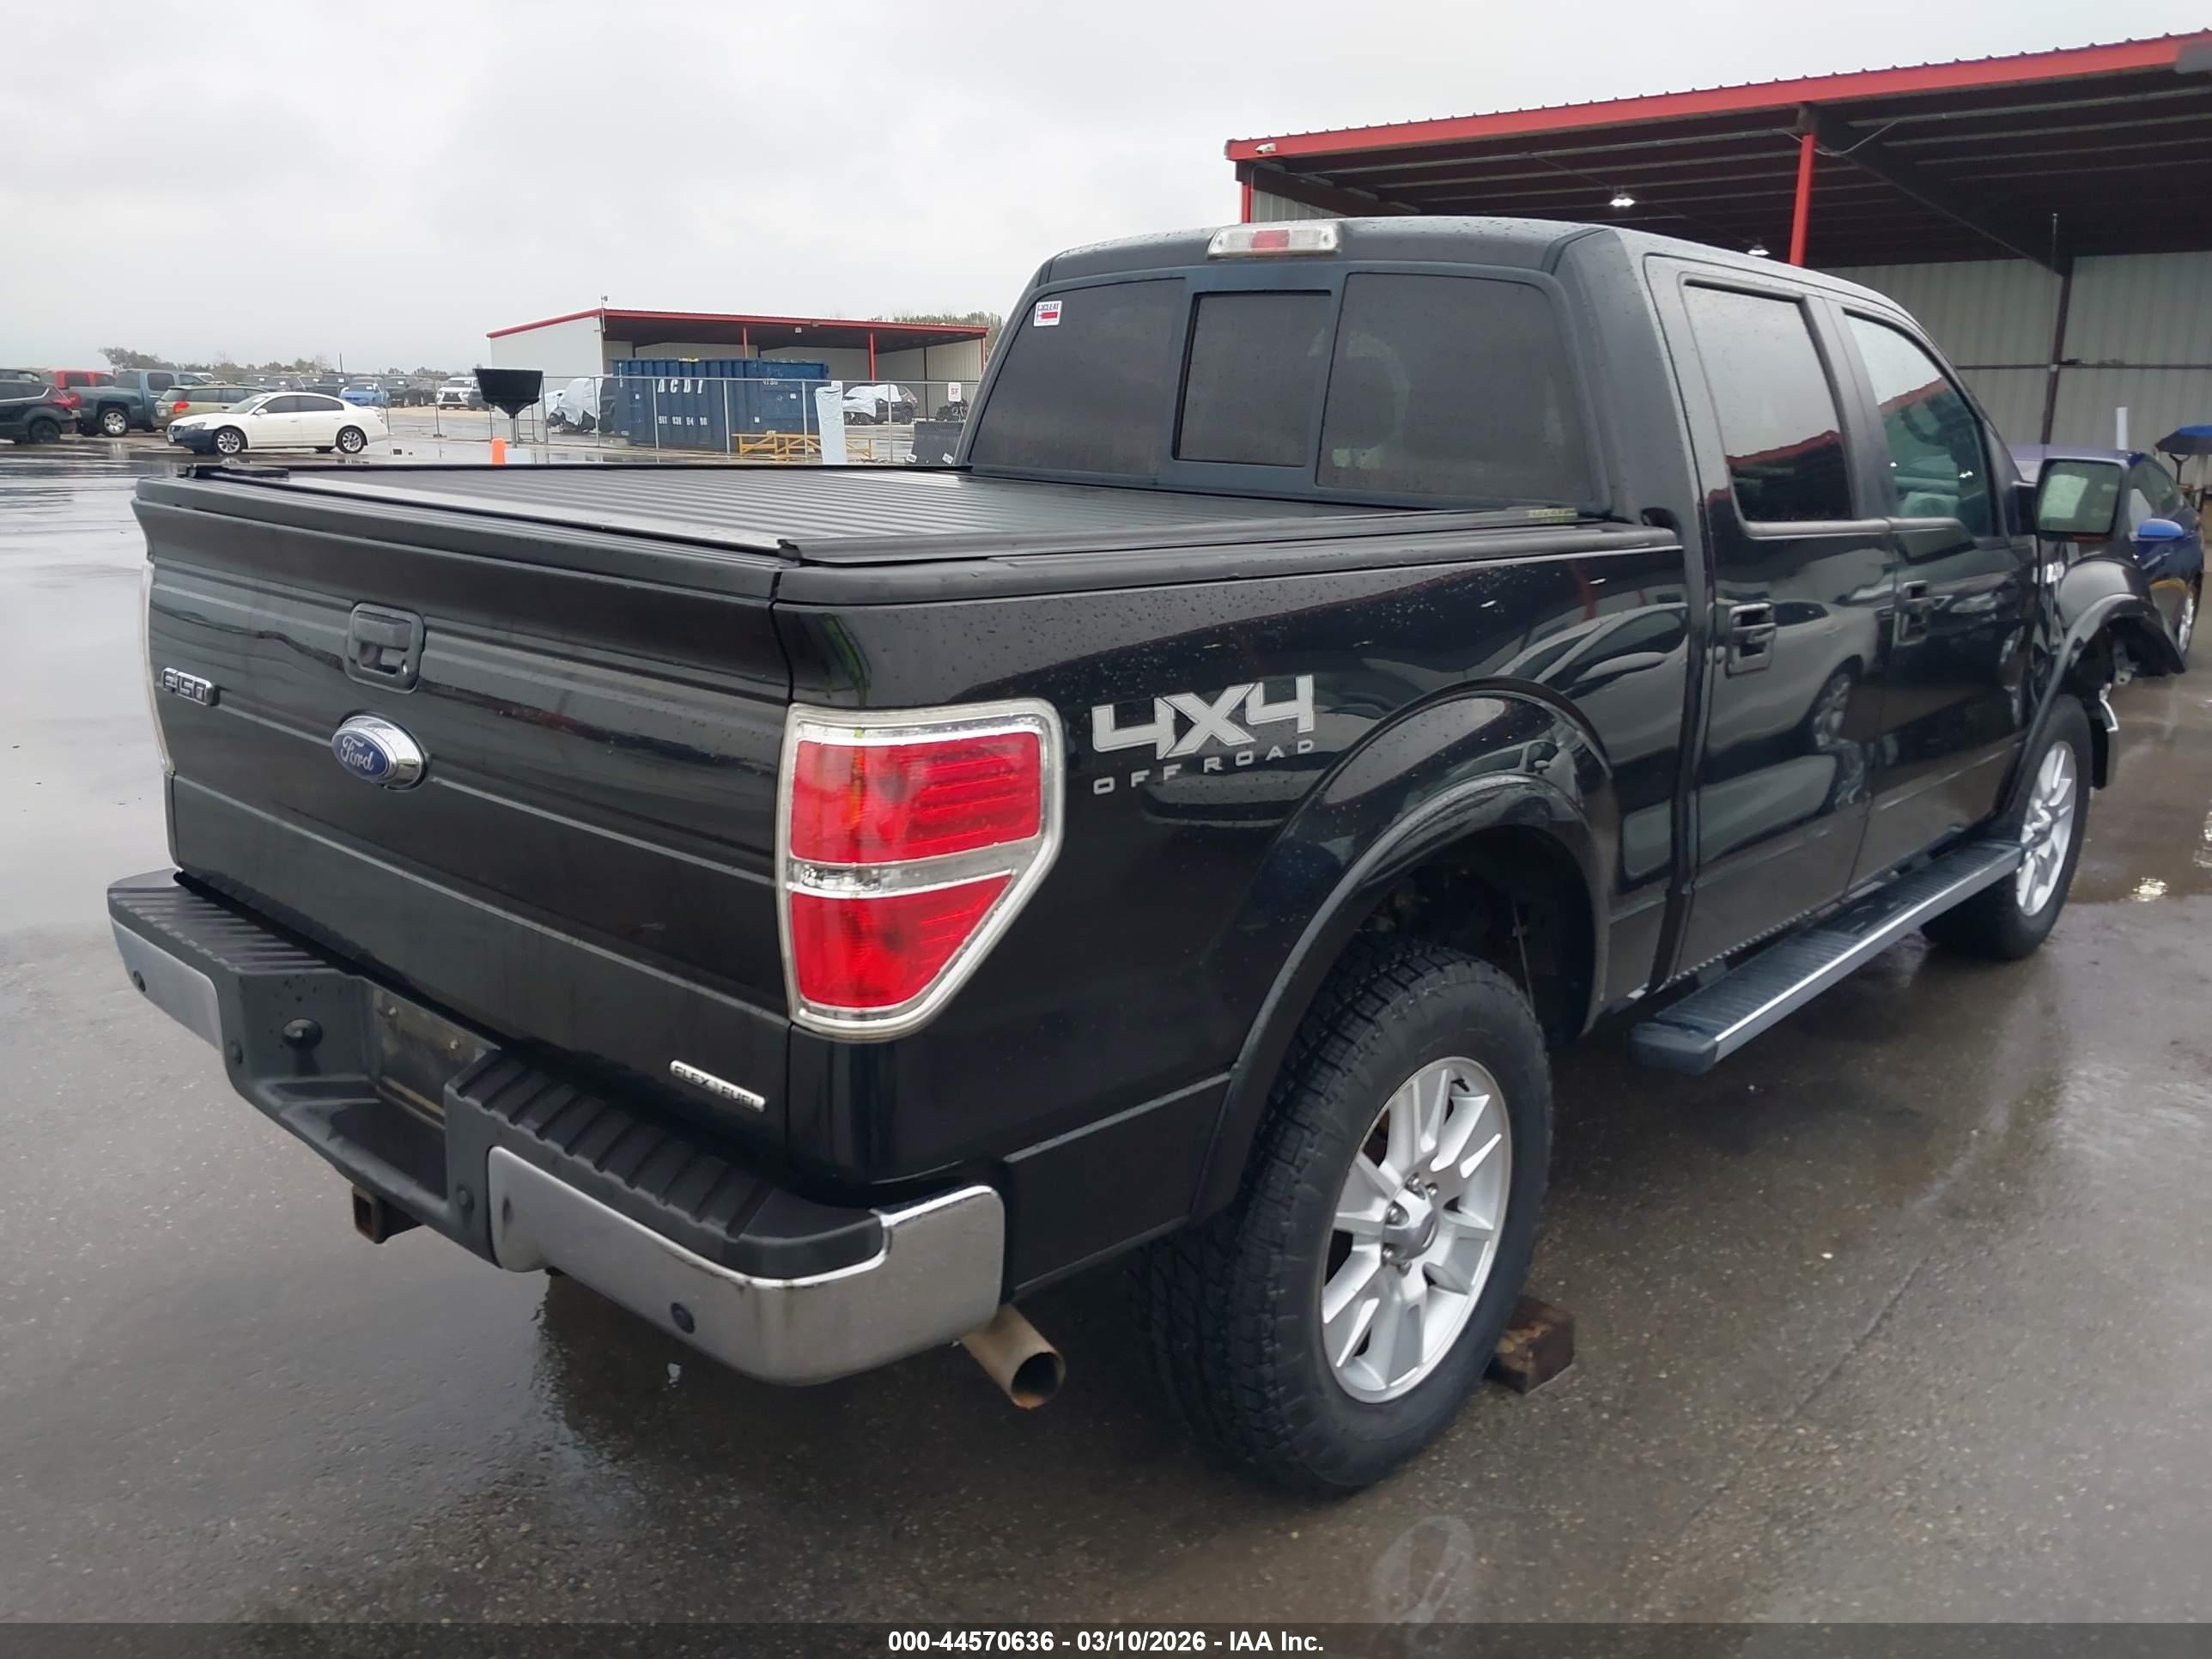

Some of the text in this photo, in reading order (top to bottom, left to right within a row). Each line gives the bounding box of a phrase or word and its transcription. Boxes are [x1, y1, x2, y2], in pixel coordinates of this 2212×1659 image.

[341, 736, 374, 771] Ford
[1093, 739, 1315, 795] OFF ROAD
